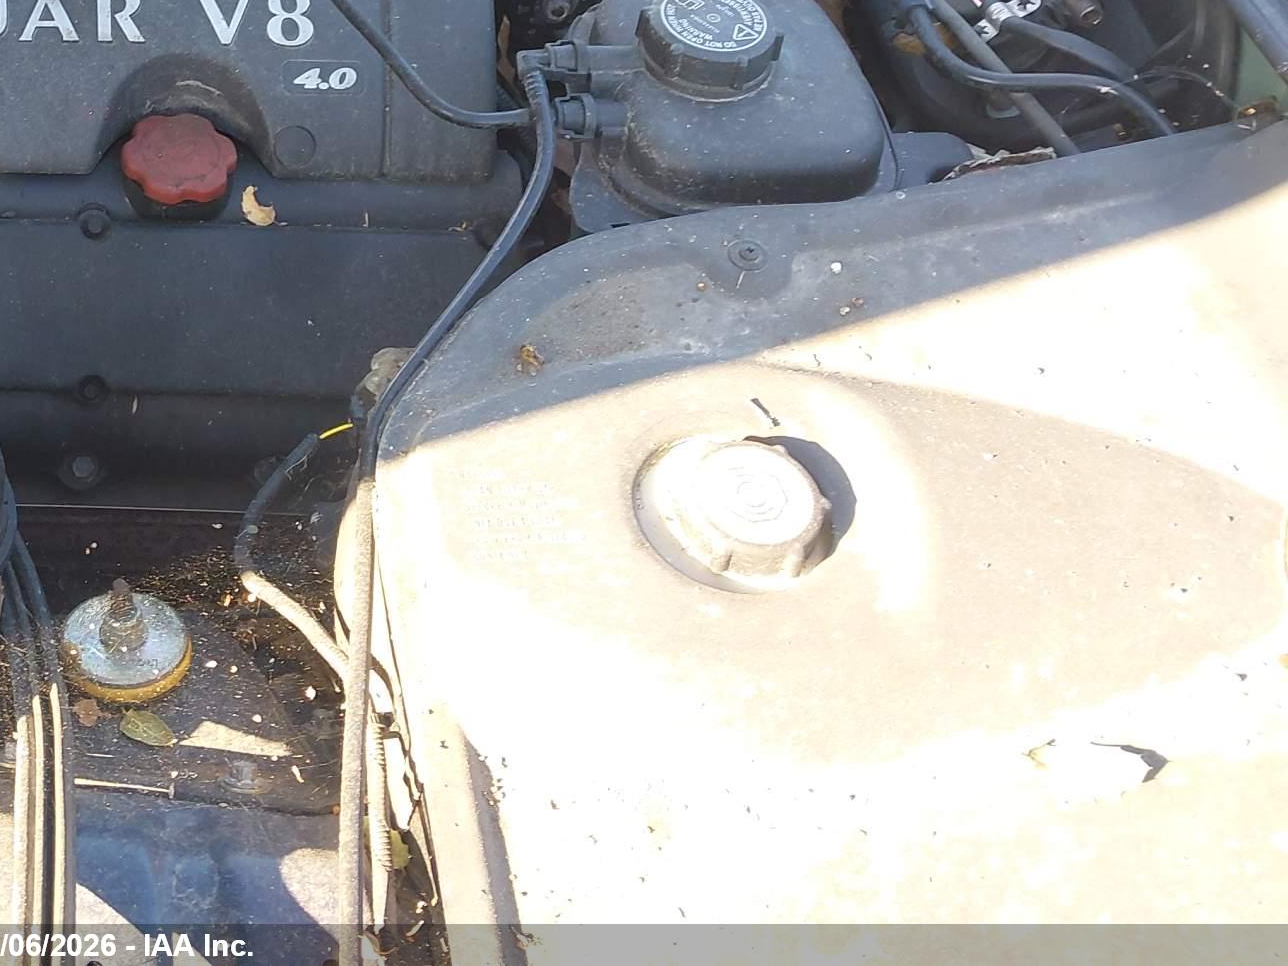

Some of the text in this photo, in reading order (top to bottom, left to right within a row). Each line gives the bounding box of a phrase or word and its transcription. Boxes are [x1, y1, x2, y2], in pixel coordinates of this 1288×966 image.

[678, 18, 713, 40] WARNING
[682, 30, 703, 44] OPEN
[704, 40, 723, 48] NOT
[293, 67, 358, 90] 4.0
